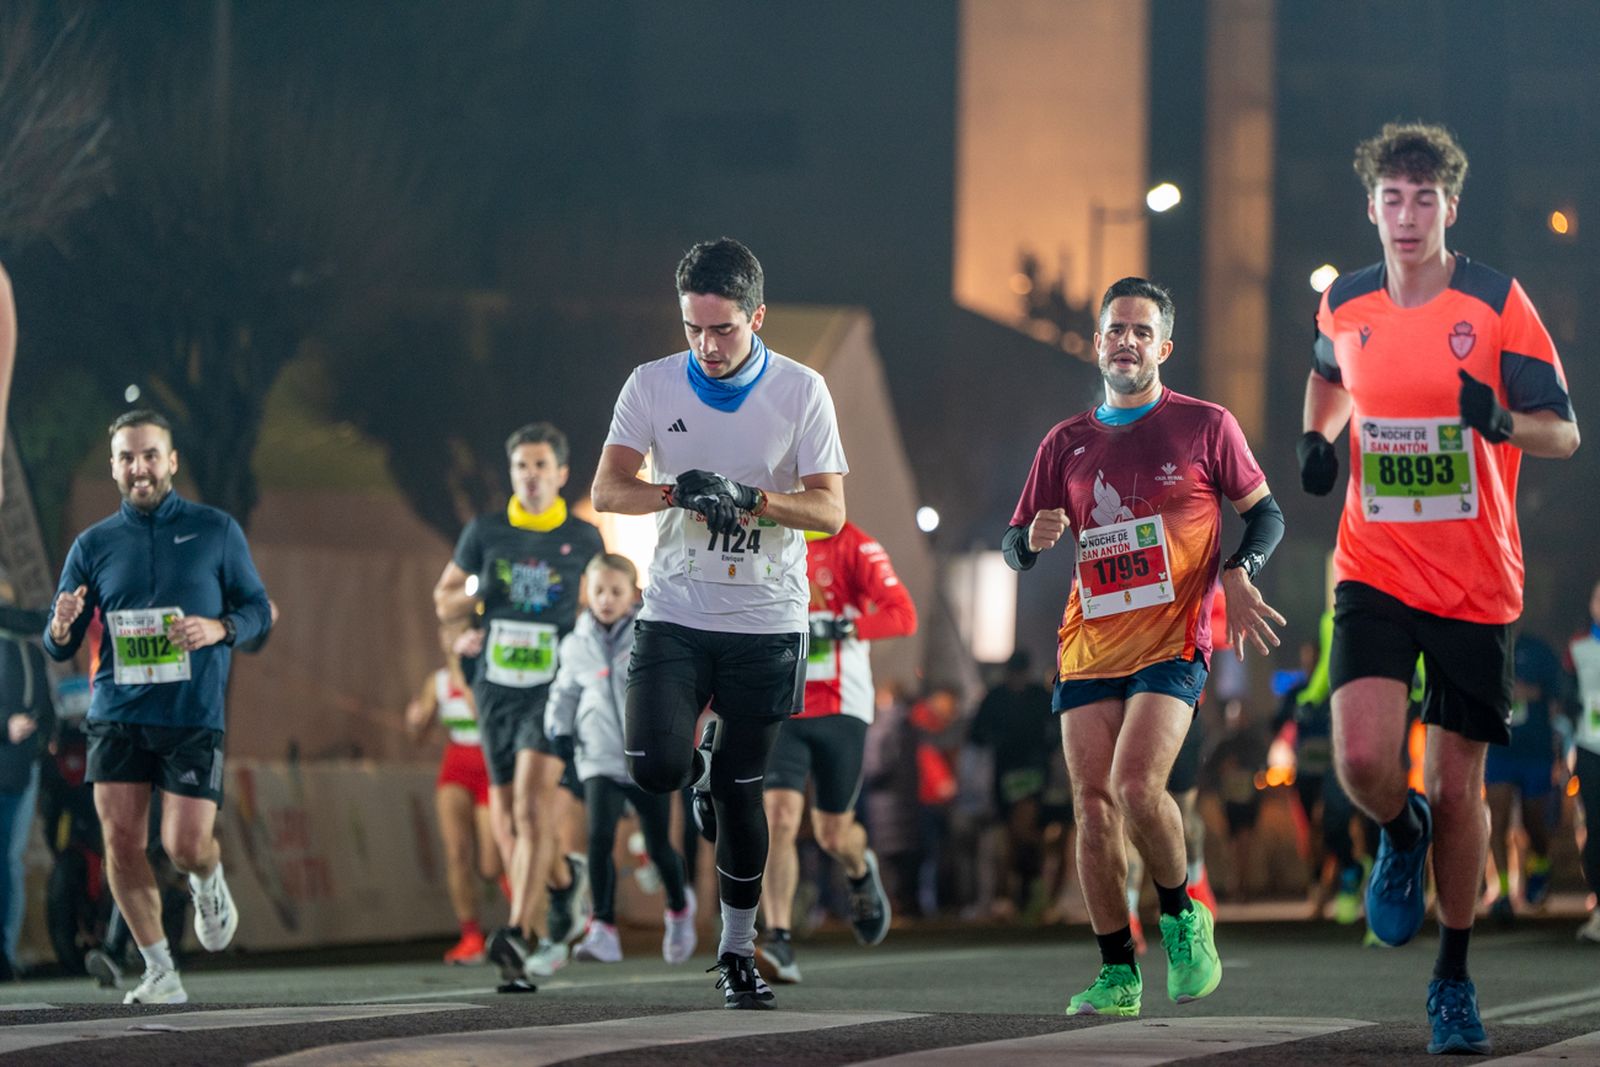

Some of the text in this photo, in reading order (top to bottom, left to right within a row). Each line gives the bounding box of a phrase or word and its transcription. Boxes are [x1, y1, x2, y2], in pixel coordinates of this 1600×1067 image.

[1381, 430, 1426, 440] NOCHE DE
[1370, 442, 1389, 452] SAN
[1379, 454, 1455, 486] 8893
[707, 525, 761, 554] 7124
[1089, 536, 1116, 547] NOCHE
[1118, 532, 1129, 542] DE
[721, 554, 744, 563] Enrique
[1082, 549, 1099, 561] SAN
[1093, 551, 1149, 585] 1795
[127, 636, 171, 658] 3012
